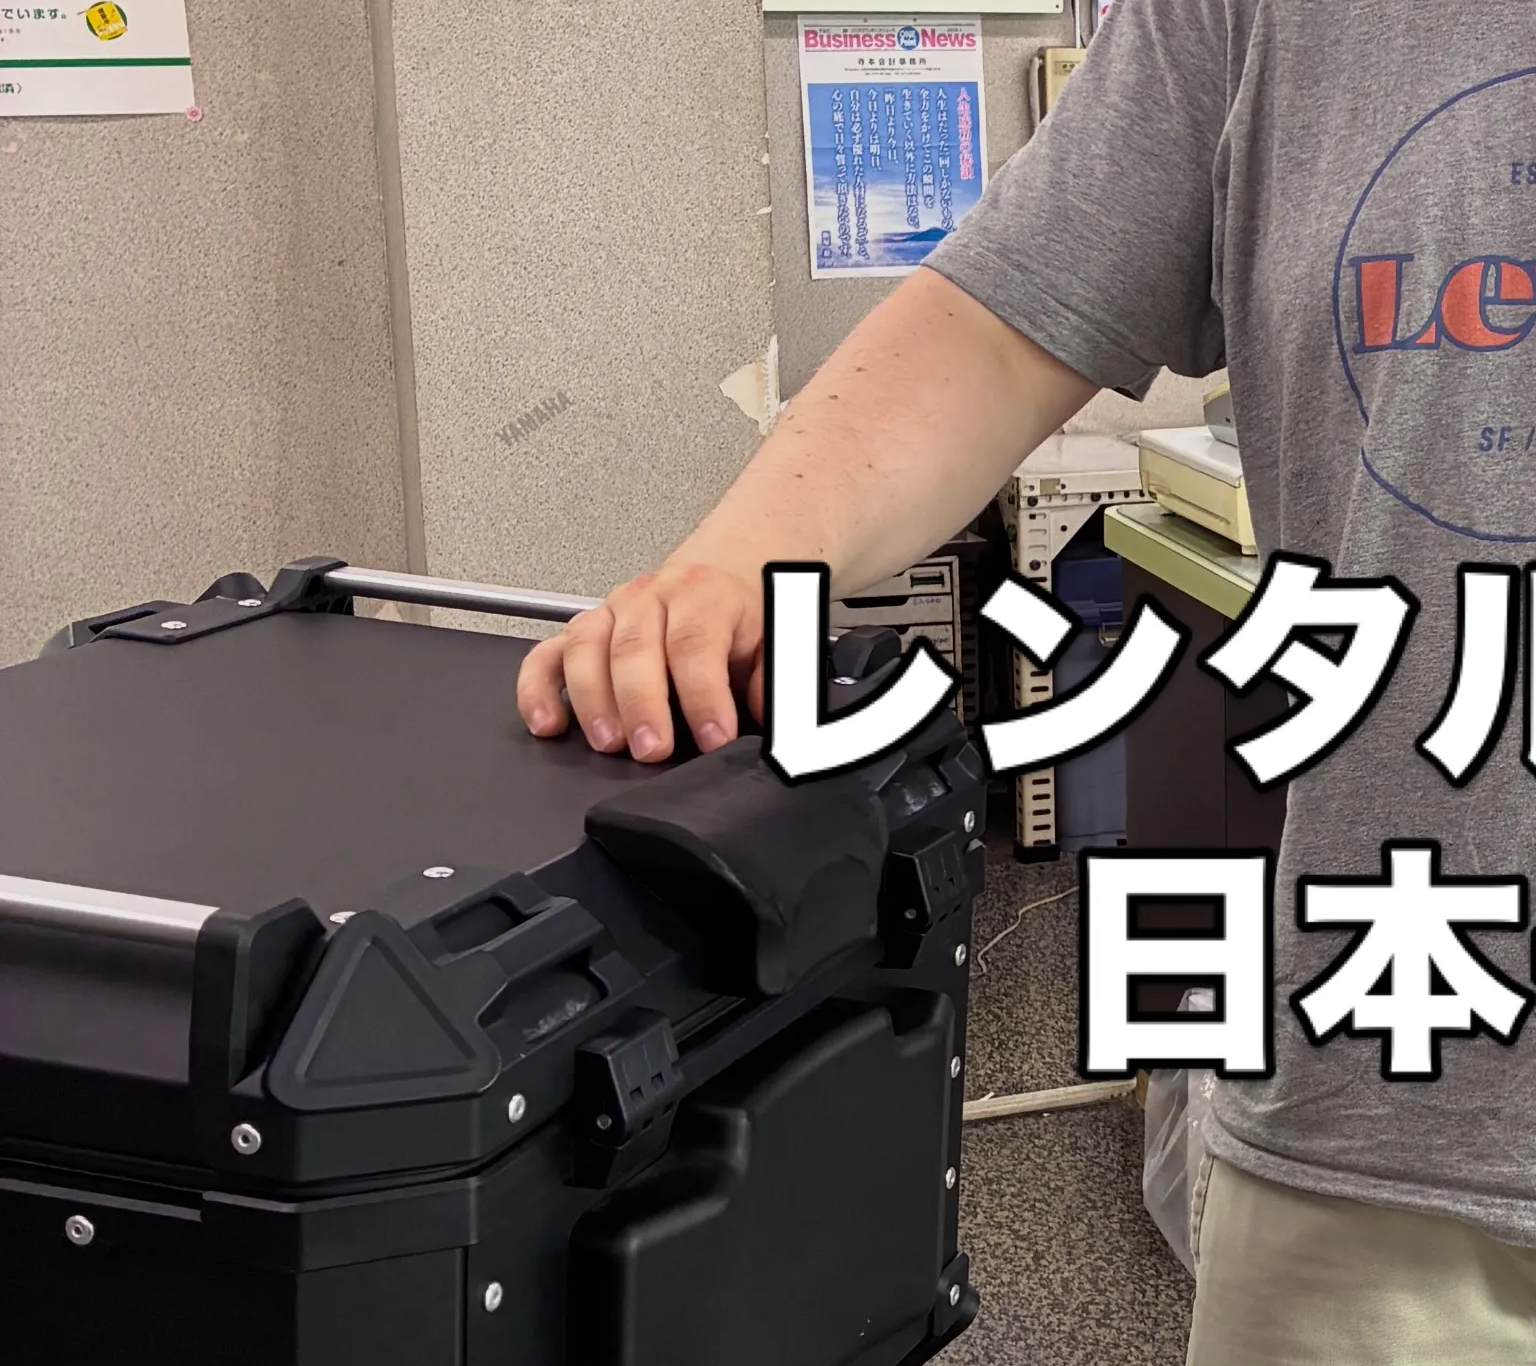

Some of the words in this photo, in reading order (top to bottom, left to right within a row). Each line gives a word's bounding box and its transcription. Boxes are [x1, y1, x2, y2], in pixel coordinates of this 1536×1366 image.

[804, 29, 896, 49] Business
[921, 28, 976, 49] News
[500, 389, 574, 446] YAMAHA
[1479, 426, 1513, 454] SF
